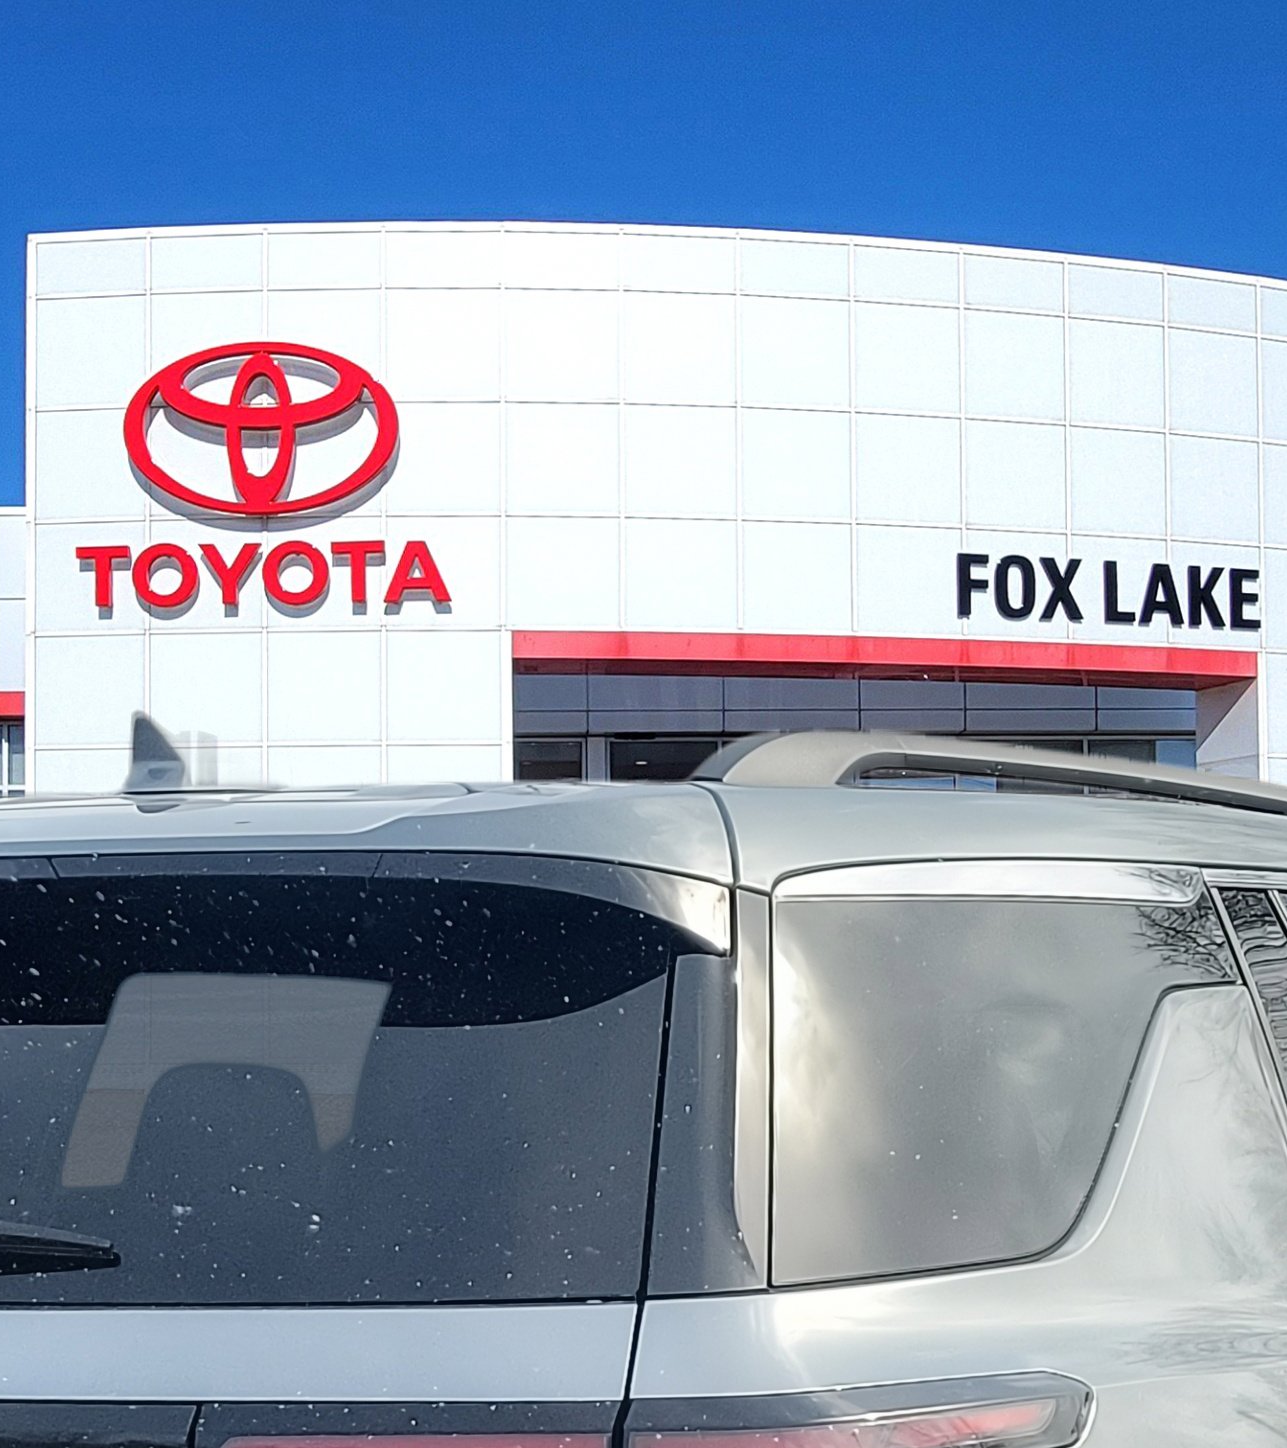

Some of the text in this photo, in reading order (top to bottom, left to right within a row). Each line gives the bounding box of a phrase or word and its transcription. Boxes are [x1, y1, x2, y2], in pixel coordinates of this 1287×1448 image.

[76, 540, 452, 615] TOYOTA
[956, 552, 1261, 630] FOX LAKE
